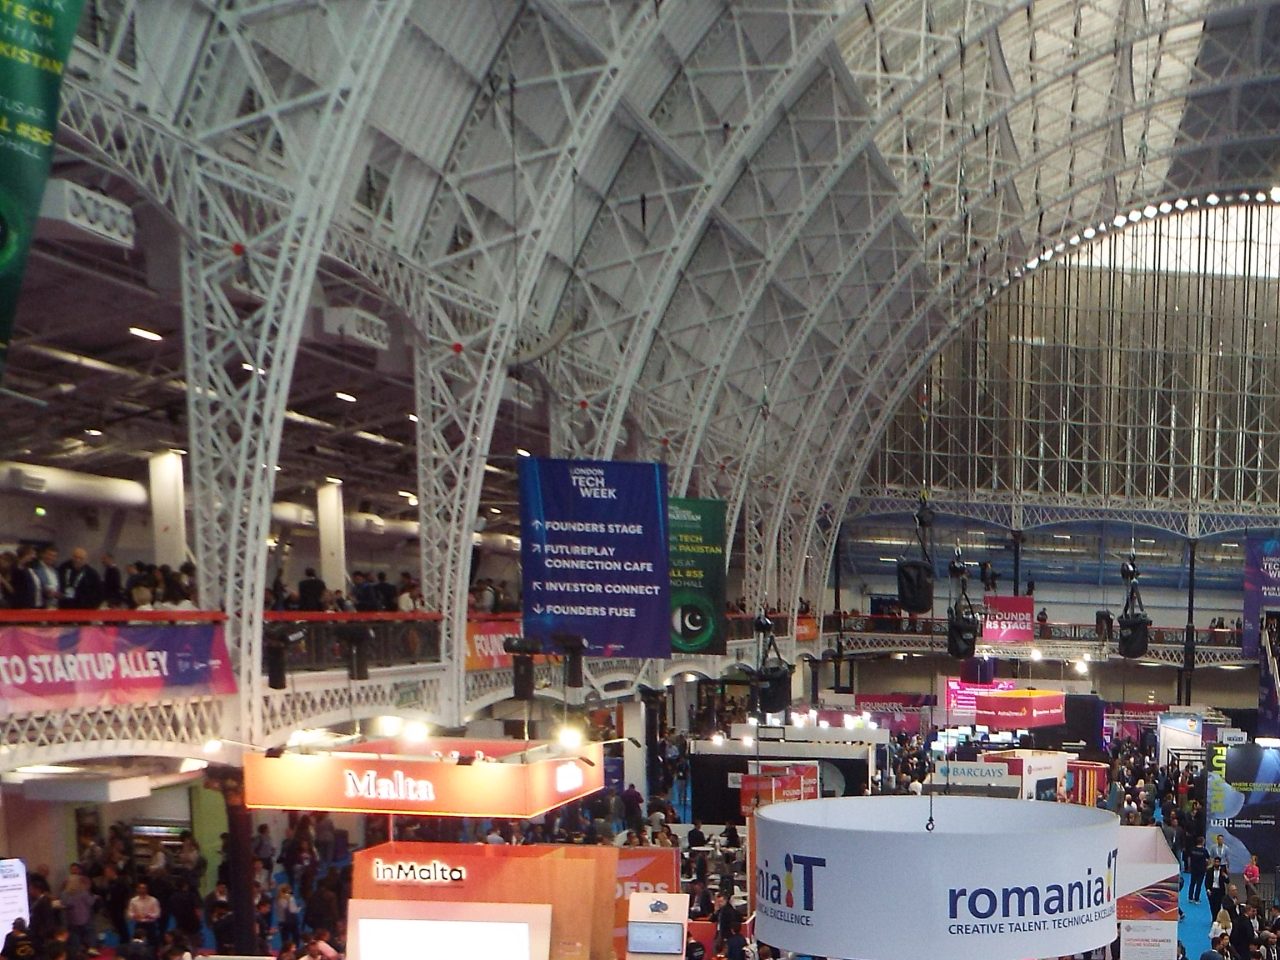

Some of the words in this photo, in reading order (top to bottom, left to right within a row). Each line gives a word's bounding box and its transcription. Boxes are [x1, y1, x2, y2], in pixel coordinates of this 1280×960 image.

[570, 468, 604, 476] LONDON
[571, 475, 605, 488] TECH
[580, 487, 617, 499] WEEK
[545, 520, 606, 533] FOUNDERS
[608, 523, 643, 535] STAGE
[544, 545, 615, 557] FUTUREPLAY
[544, 559, 622, 571] CONNECTION
[624, 561, 654, 572] CAFE
[546, 582, 603, 594] INVESTOR
[604, 583, 661, 596] CONNECT
[546, 605, 607, 616] FOUNDERS
[608, 606, 636, 618] FUSE
[1000, 621, 1032, 631] STAGE
[0, 655, 26, 685] TO
[28, 653, 115, 683] STARTUP
[117, 651, 169, 678] ALLEY
[952, 767, 1004, 778] BARCLAYS
[345, 770, 435, 801] Malta
[1211, 818, 1233, 828] ual:
[374, 859, 466, 883] inMalta
[948, 922, 1004, 935] CREATIVE
[1009, 920, 1049, 933] TALENT.
[1052, 913, 1094, 930] TECHNICAL
